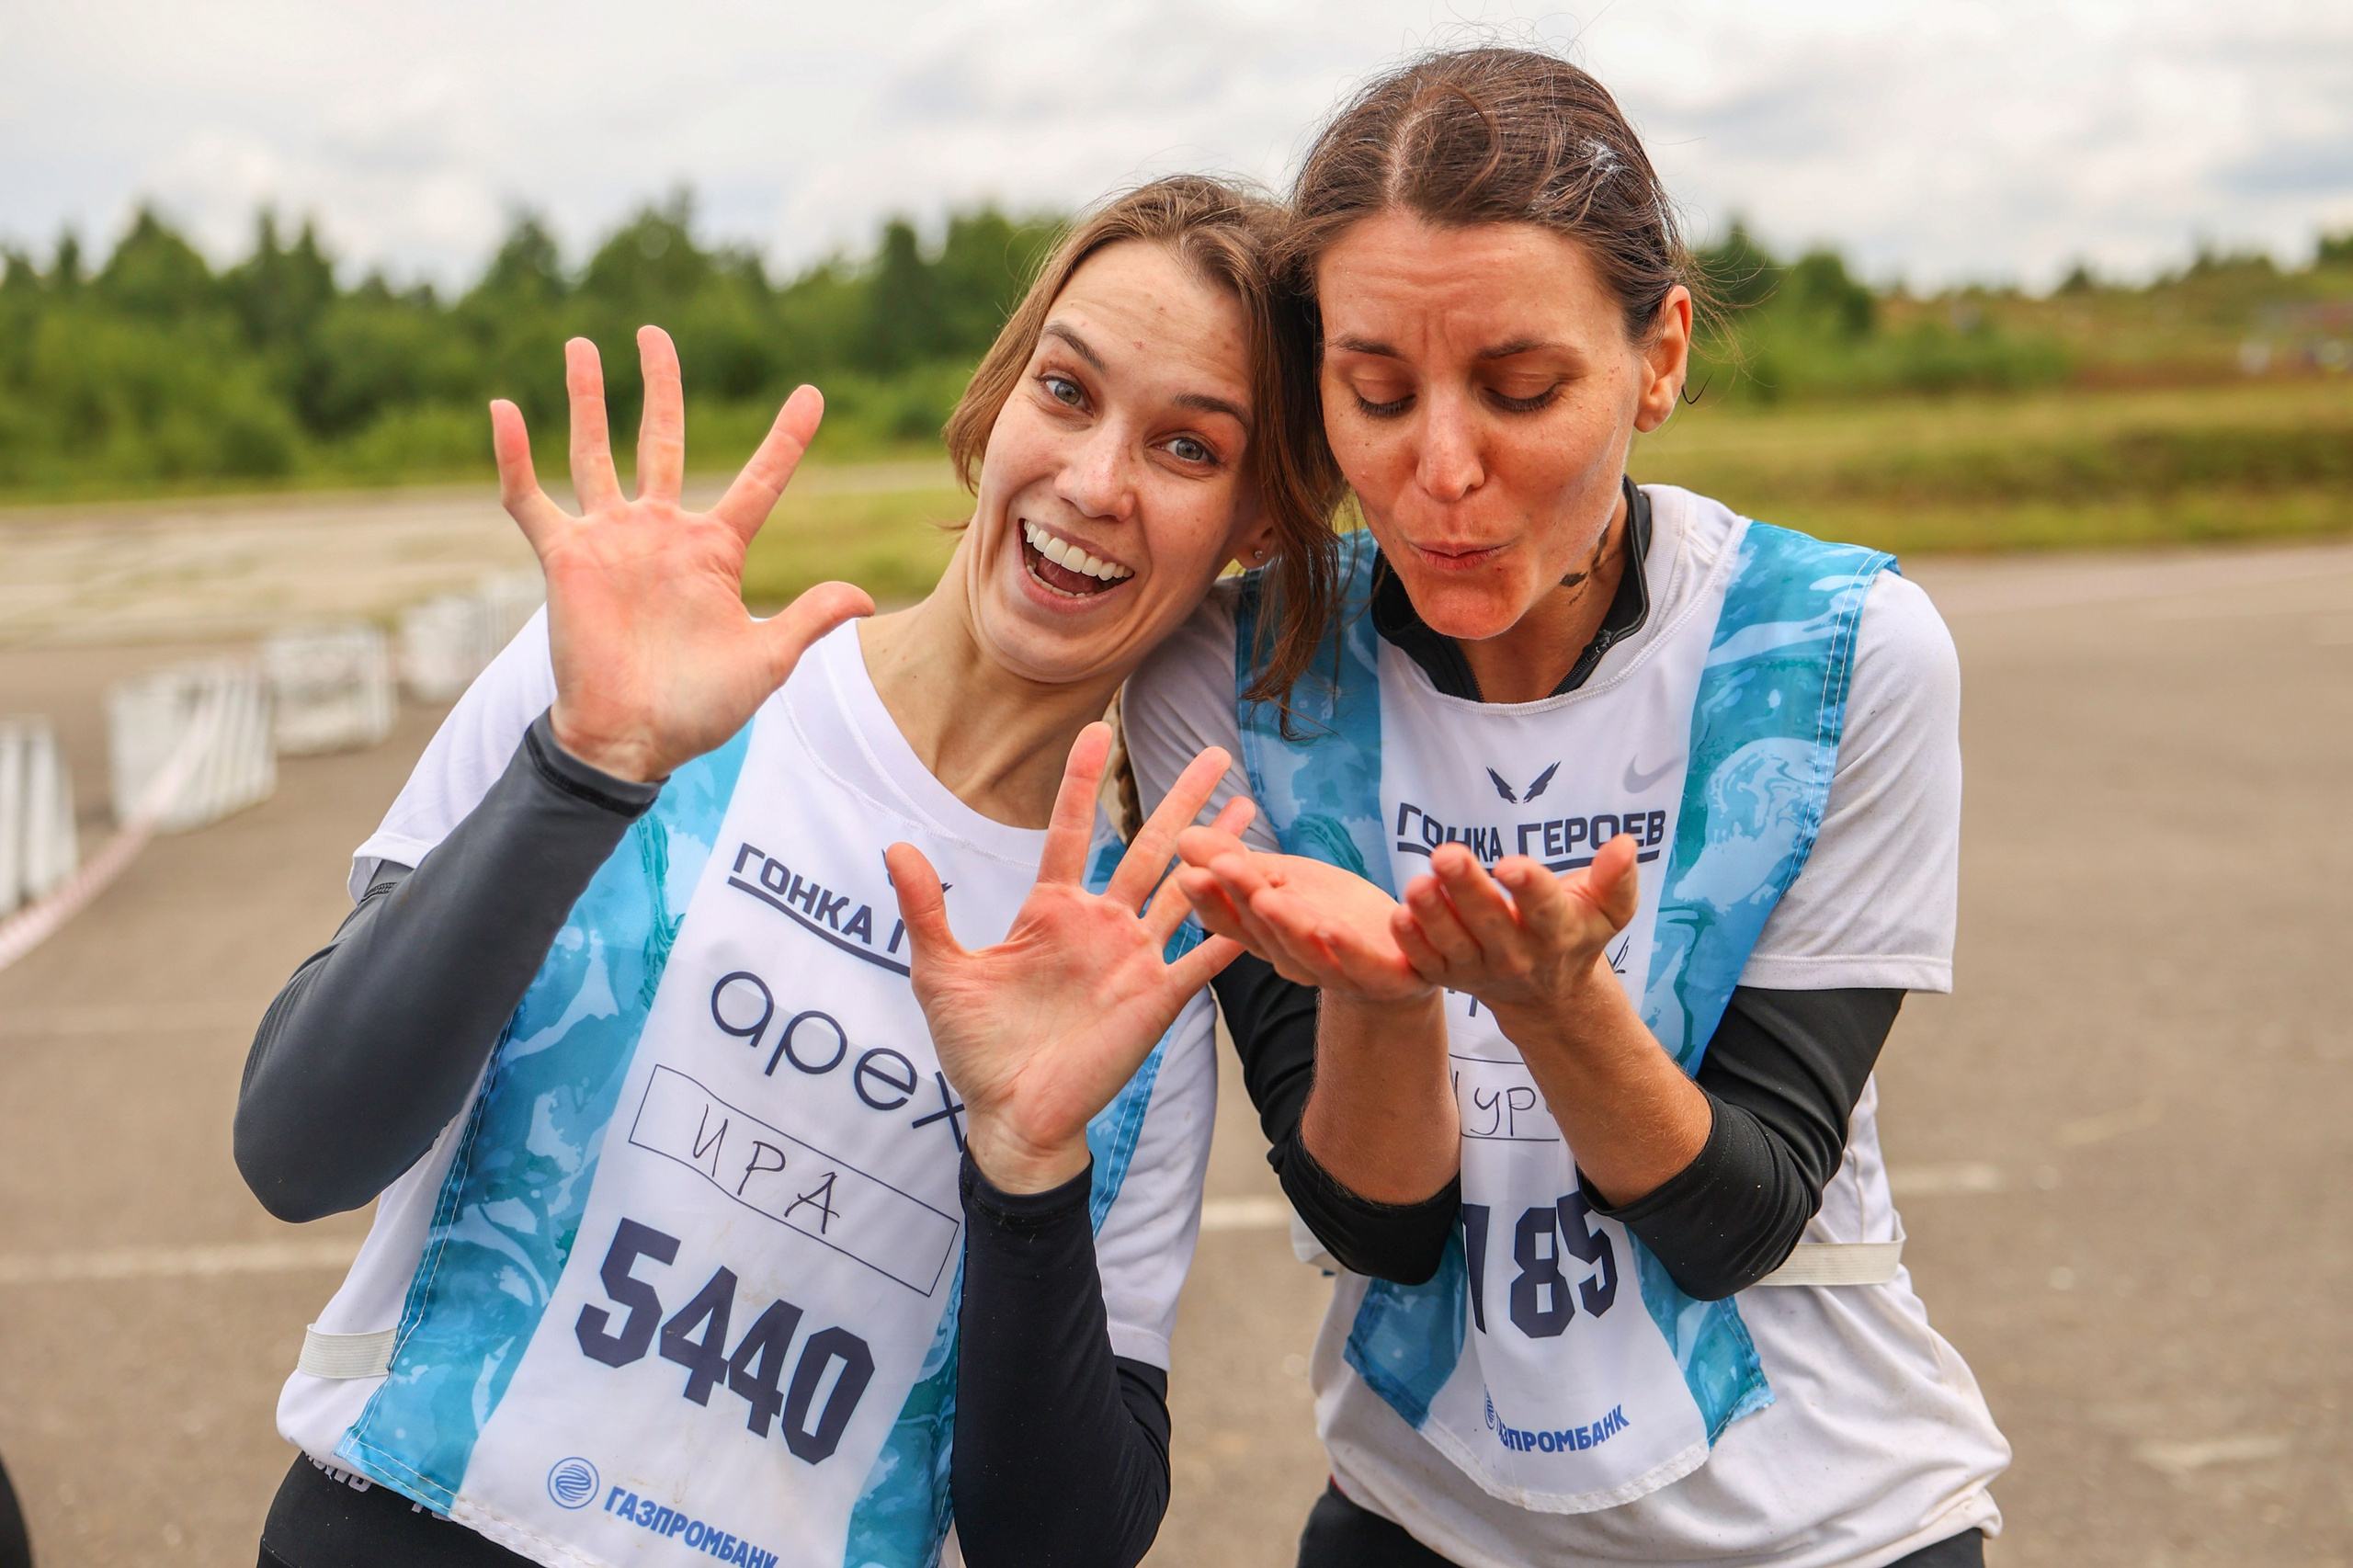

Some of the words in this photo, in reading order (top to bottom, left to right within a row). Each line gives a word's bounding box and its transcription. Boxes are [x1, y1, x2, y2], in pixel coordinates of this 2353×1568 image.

[733, 843, 873, 945] ГОНКА
[1396, 802, 1504, 863] ГОНКА
[1518, 810, 1666, 858] ГЕРОЕВ
[710, 971, 966, 1153] apex
[692, 1103, 840, 1235] ИРА
[574, 1217, 876, 1466] 5440
